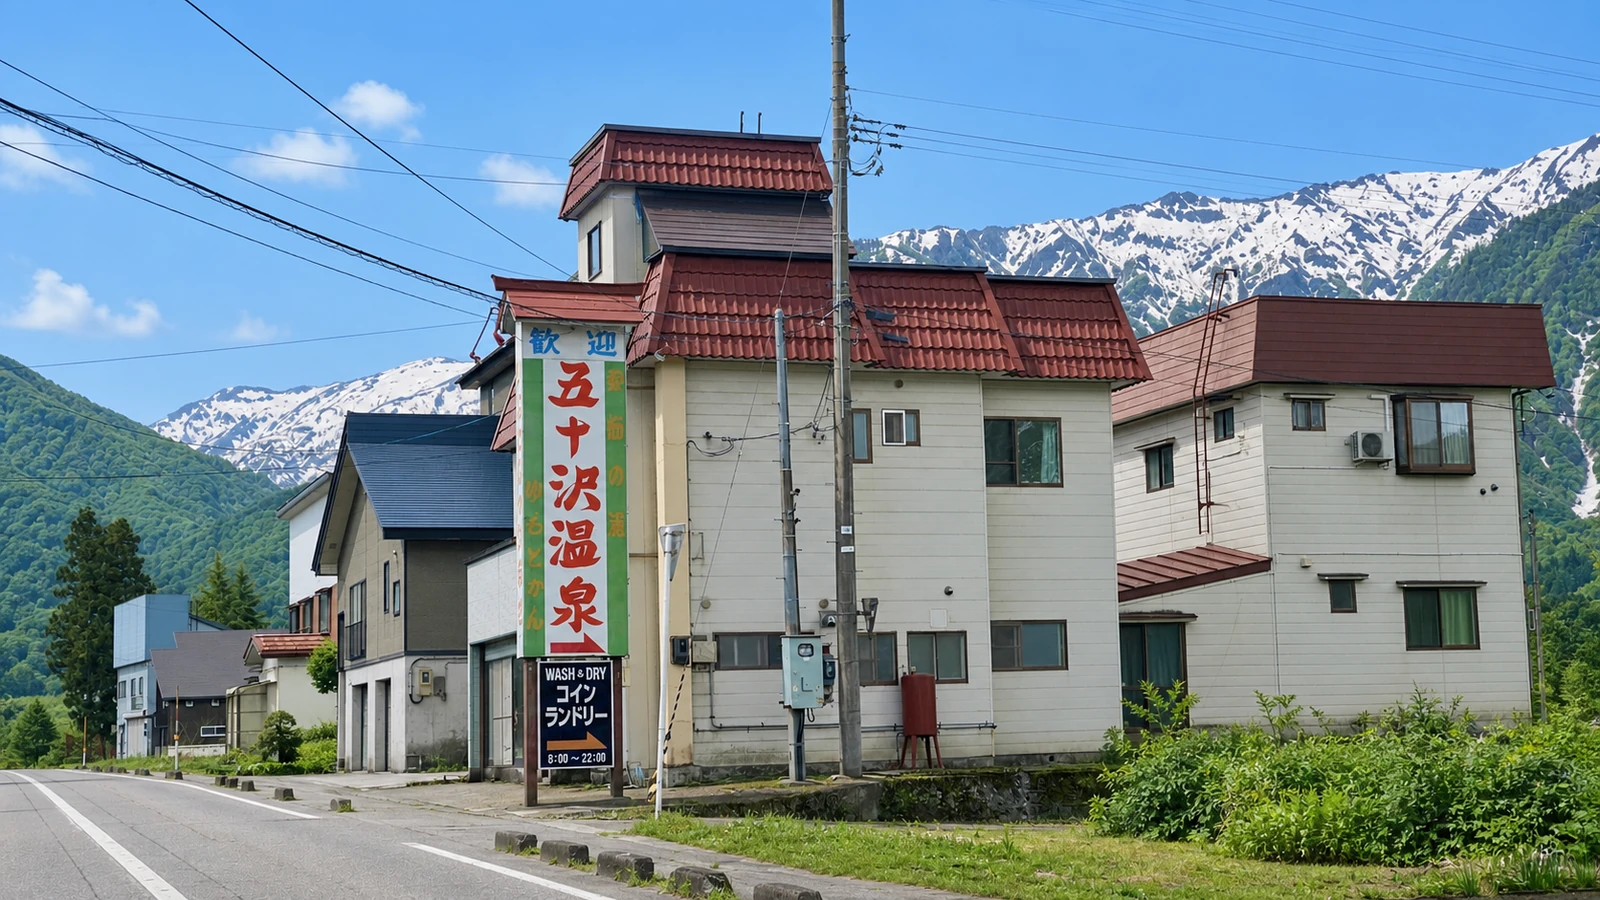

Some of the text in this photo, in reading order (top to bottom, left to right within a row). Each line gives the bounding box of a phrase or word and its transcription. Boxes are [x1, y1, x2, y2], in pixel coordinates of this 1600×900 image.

[529, 327, 617, 357] 歓迎
[548, 361, 604, 633] 五十沢温泉
[525, 479, 545, 631] ゆもとかん
[545, 666, 607, 681] WASH & DRY
[556, 683, 596, 704] コイン
[545, 705, 608, 728] ランドリー
[547, 753, 569, 764] 8:00
[581, 752, 606, 763] 22:00
